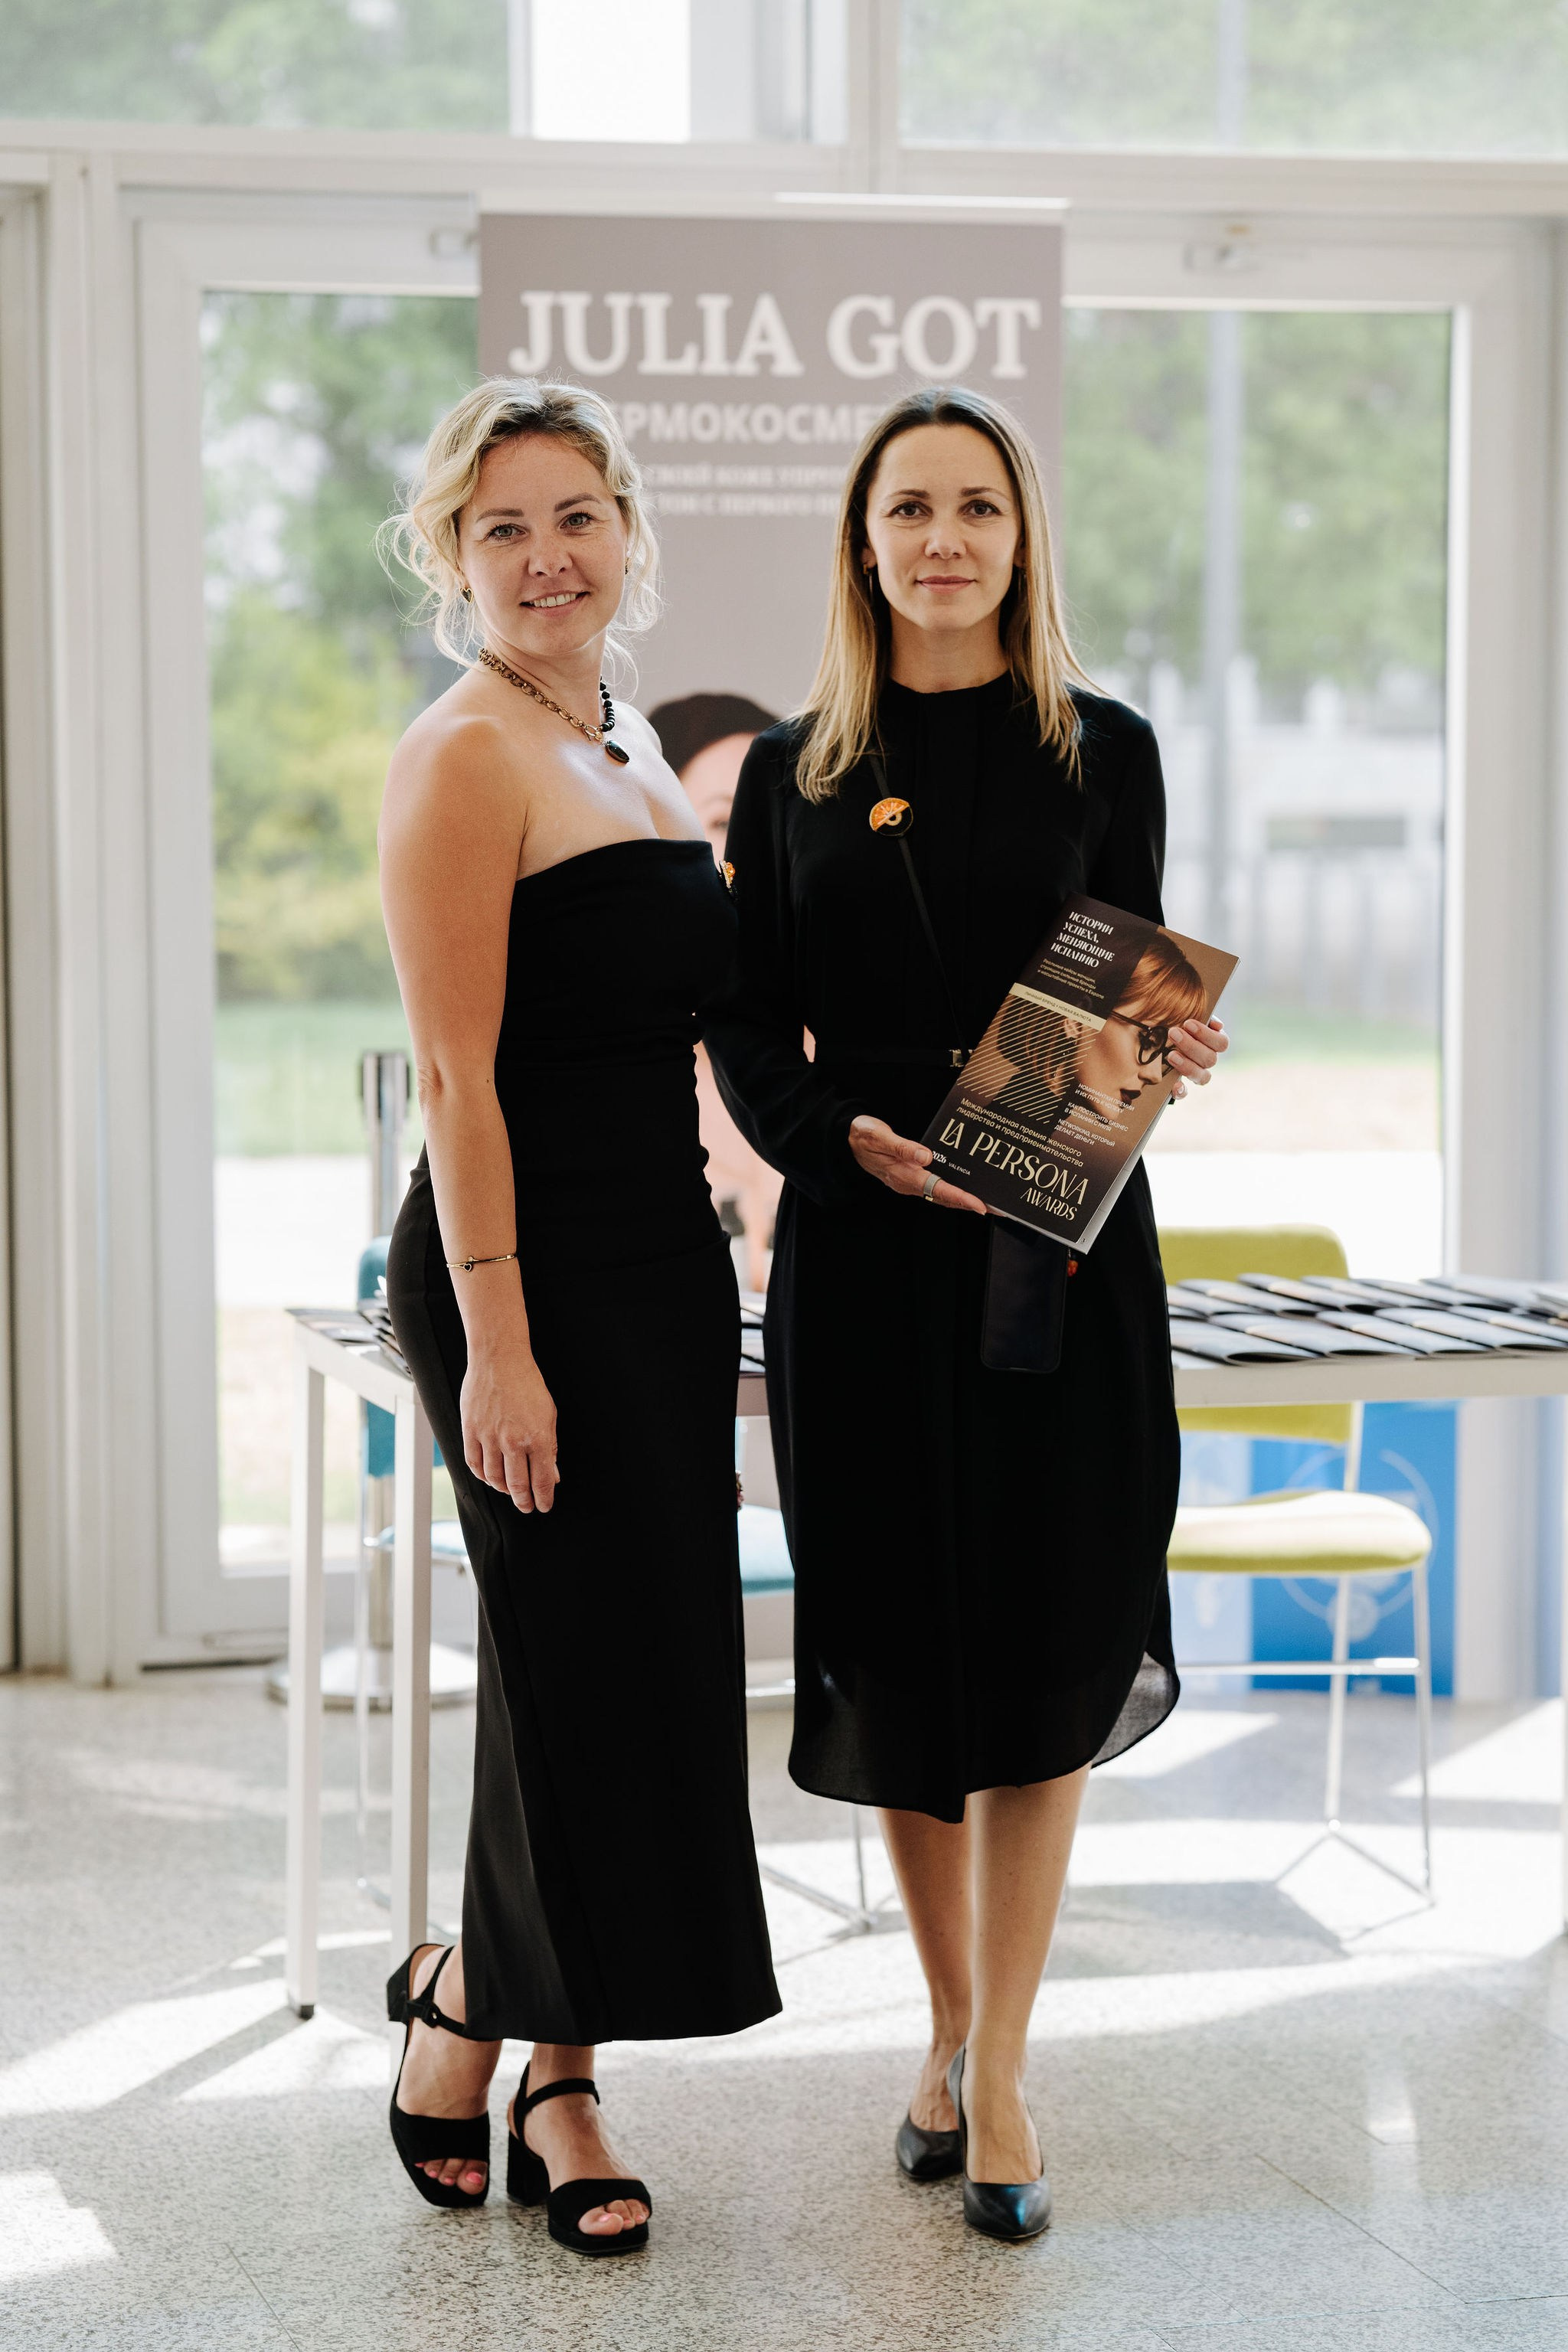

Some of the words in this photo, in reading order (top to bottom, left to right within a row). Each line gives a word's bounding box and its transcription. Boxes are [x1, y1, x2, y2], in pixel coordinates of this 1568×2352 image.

[508, 289, 804, 378] JULIA
[825, 294, 1042, 381] GOT
[612, 401, 888, 446] РМОКОСМЕ
[1061, 921, 1102, 943] УСПЕХА,
[1067, 911, 1114, 935] ИСТОРИИ
[1049, 942, 1100, 968] ИСПАНИЮ
[1055, 932, 1116, 962] МЕНЯЮЩИЕ
[1086, 1094, 1101, 1103] ПУТЬ
[956, 1106, 995, 1127] лидерства
[960, 1097, 1020, 1129] Международная
[1018, 1125, 1047, 1142] премия
[1046, 1138, 1082, 1157] женского
[1067, 1102, 1079, 1110] КАК
[1077, 1106, 1109, 1123] ПОСТРОИТЬ
[1108, 1119, 1129, 1132] БИЗНЕС
[1068, 1109, 1094, 1124] ИСПАНИИ
[1054, 1124, 1075, 1136] ДЕЛАЕТ
[1073, 1133, 1095, 1145] ДЕНЬГИ
[1057, 1119, 1092, 1137] NETWORKING,
[1090, 1132, 1116, 1146] КОТОРЫЙ
[938, 1118, 971, 1149] LA
[968, 1131, 1093, 1205] PERSONA
[947, 1161, 971, 1175] VALENCIA
[1019, 1186, 1079, 1221] AWARDS
